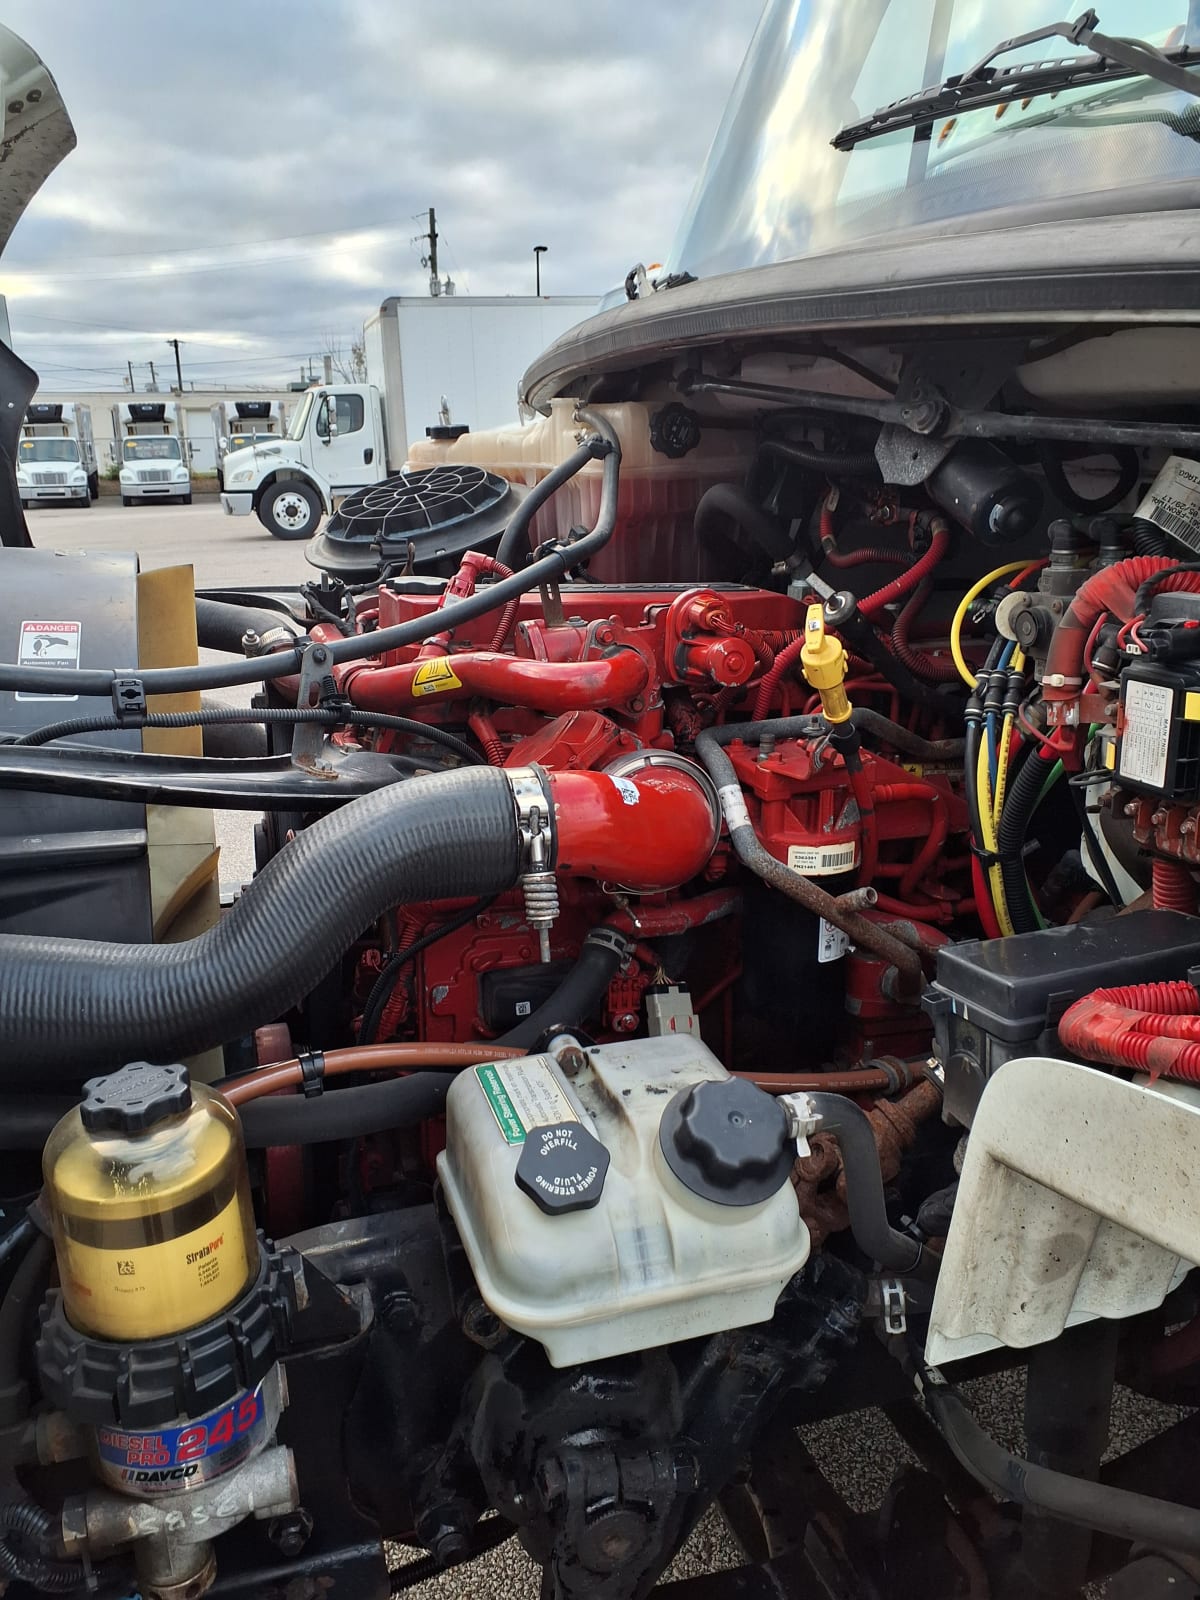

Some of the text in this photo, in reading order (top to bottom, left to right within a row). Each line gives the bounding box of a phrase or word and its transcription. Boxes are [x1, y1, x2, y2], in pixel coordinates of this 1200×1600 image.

[1160, 719, 1168, 736] MAIN
[484, 1069, 522, 1137] Power Steering Reservoir
[541, 1129, 573, 1141] DO NOT
[540, 1138, 578, 1156] OVERFILL
[535, 1166, 598, 1196] POWER STEERING
[553, 1173, 583, 1185] FLUID
[186, 1236, 224, 1265] StrataPore
[101, 1430, 168, 1451] DIESEL
[175, 1393, 258, 1464] 245
[127, 1450, 171, 1467] PRO
[135, 1464, 199, 1483] DAVCO
